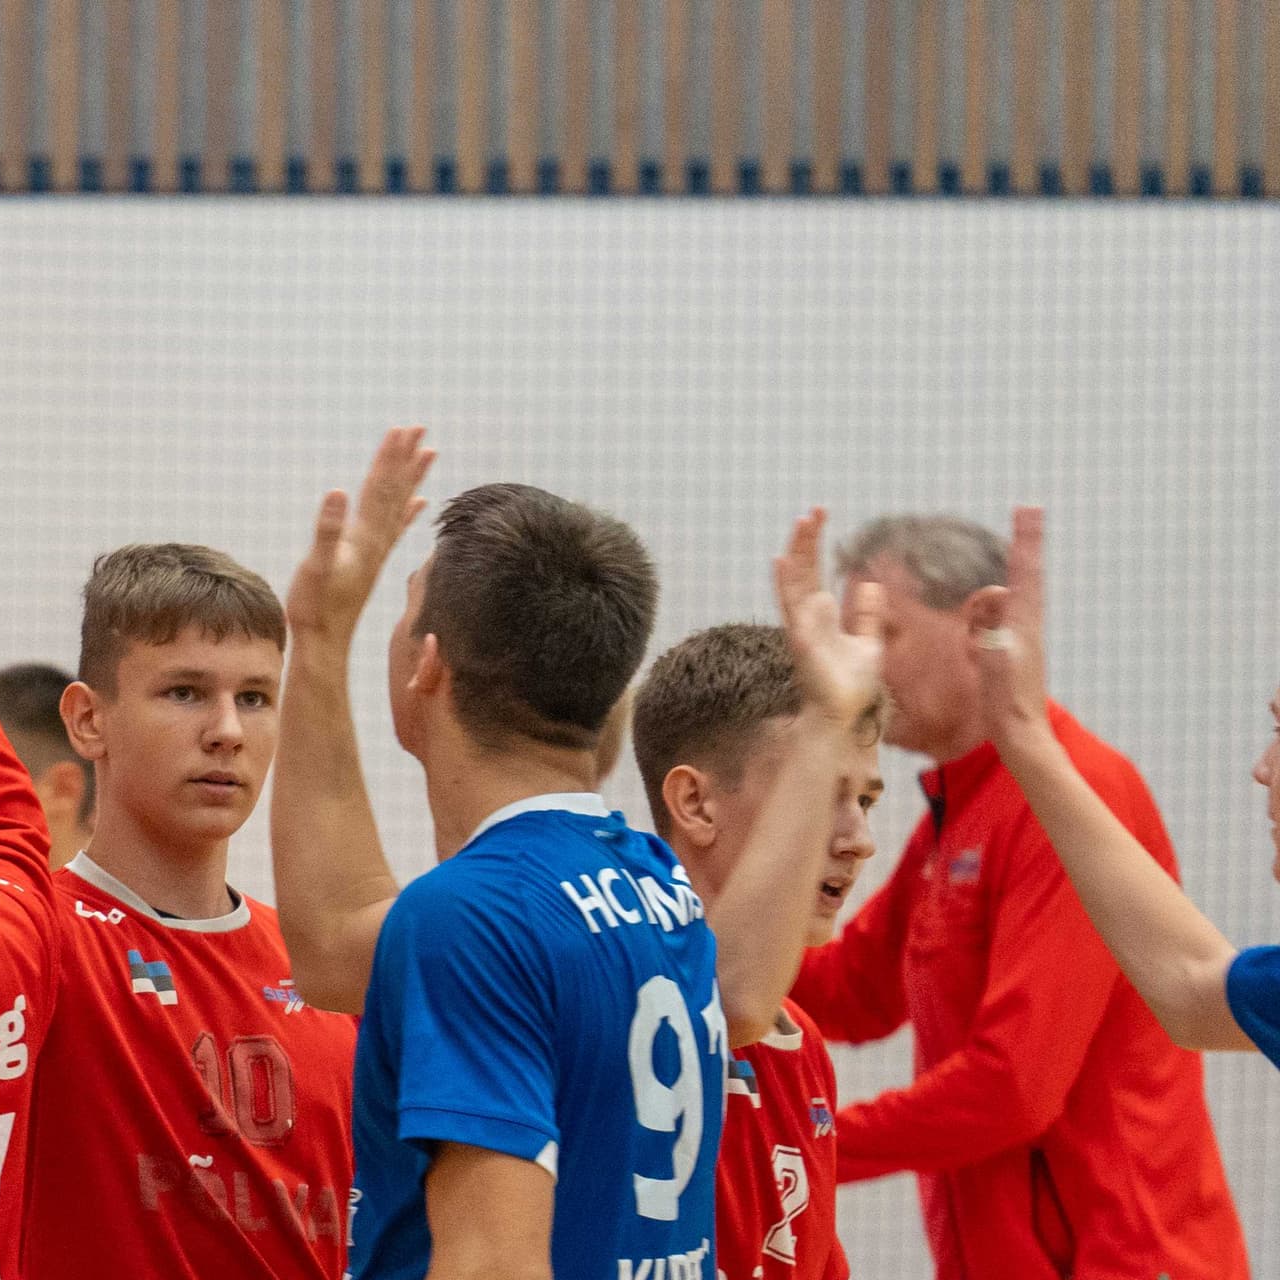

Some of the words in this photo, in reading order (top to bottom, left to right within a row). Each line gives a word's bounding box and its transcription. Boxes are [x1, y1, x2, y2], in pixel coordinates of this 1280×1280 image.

[560, 868, 642, 933] HC
[192, 1030, 298, 1147] 10
[762, 1144, 810, 1267] 2
